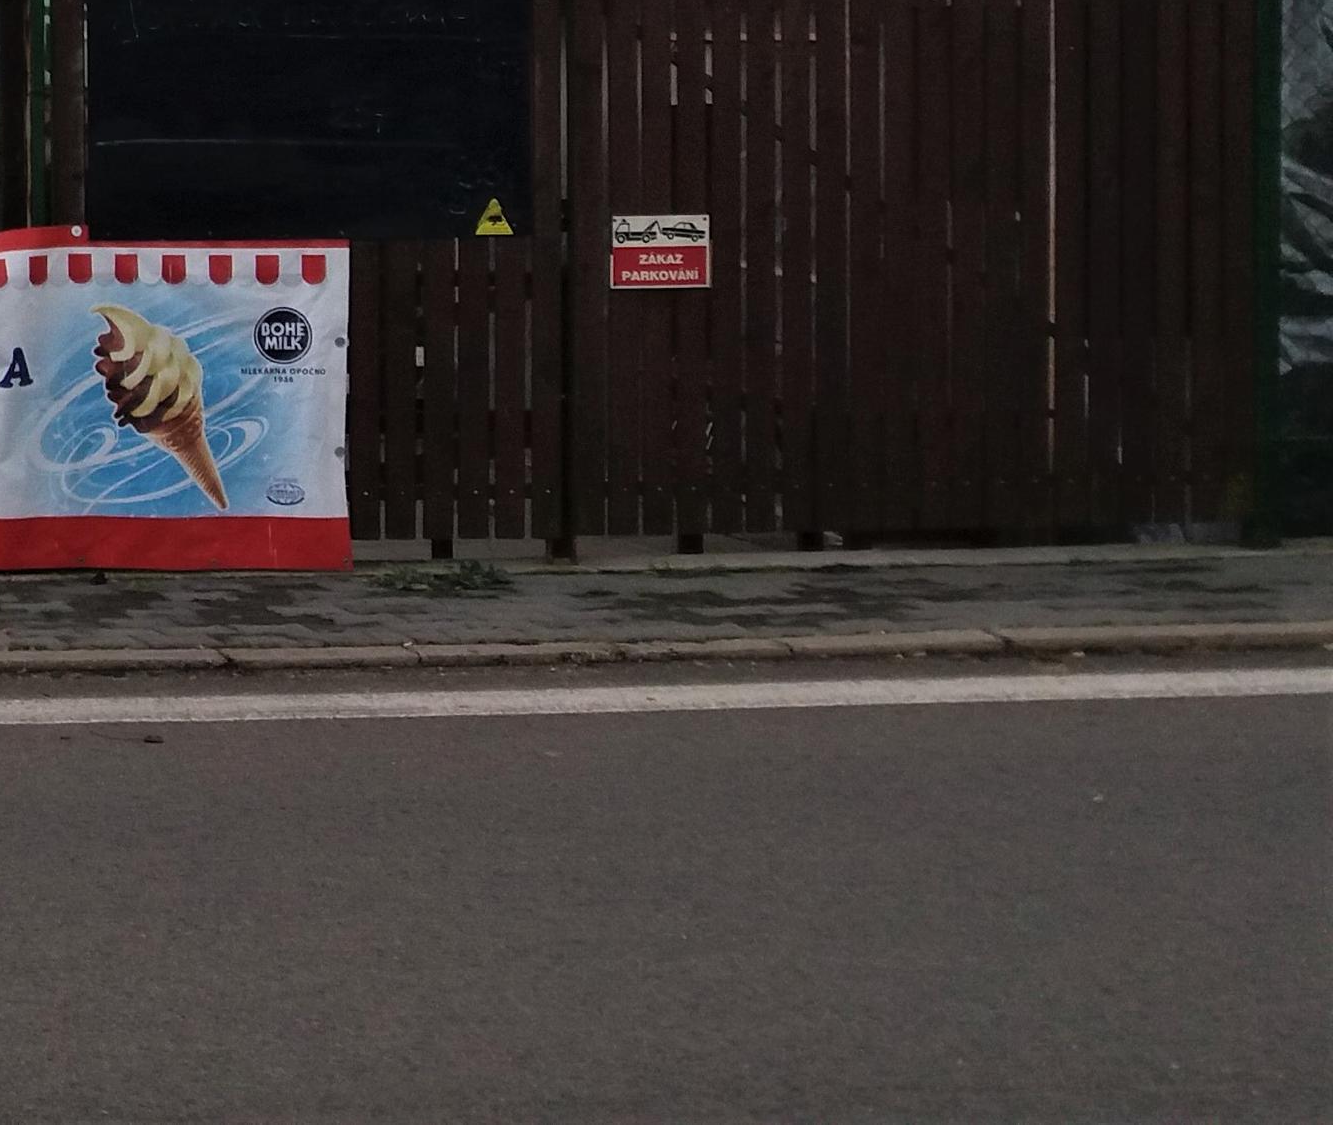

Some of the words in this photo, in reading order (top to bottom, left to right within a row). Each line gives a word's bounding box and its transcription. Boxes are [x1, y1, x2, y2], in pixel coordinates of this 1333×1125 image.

[639, 252, 684, 265] ZÁKAZ
[621, 267, 699, 281] PARKOVÁNÍ
[261, 322, 305, 337] BOHE
[264, 336, 303, 351] MILK
